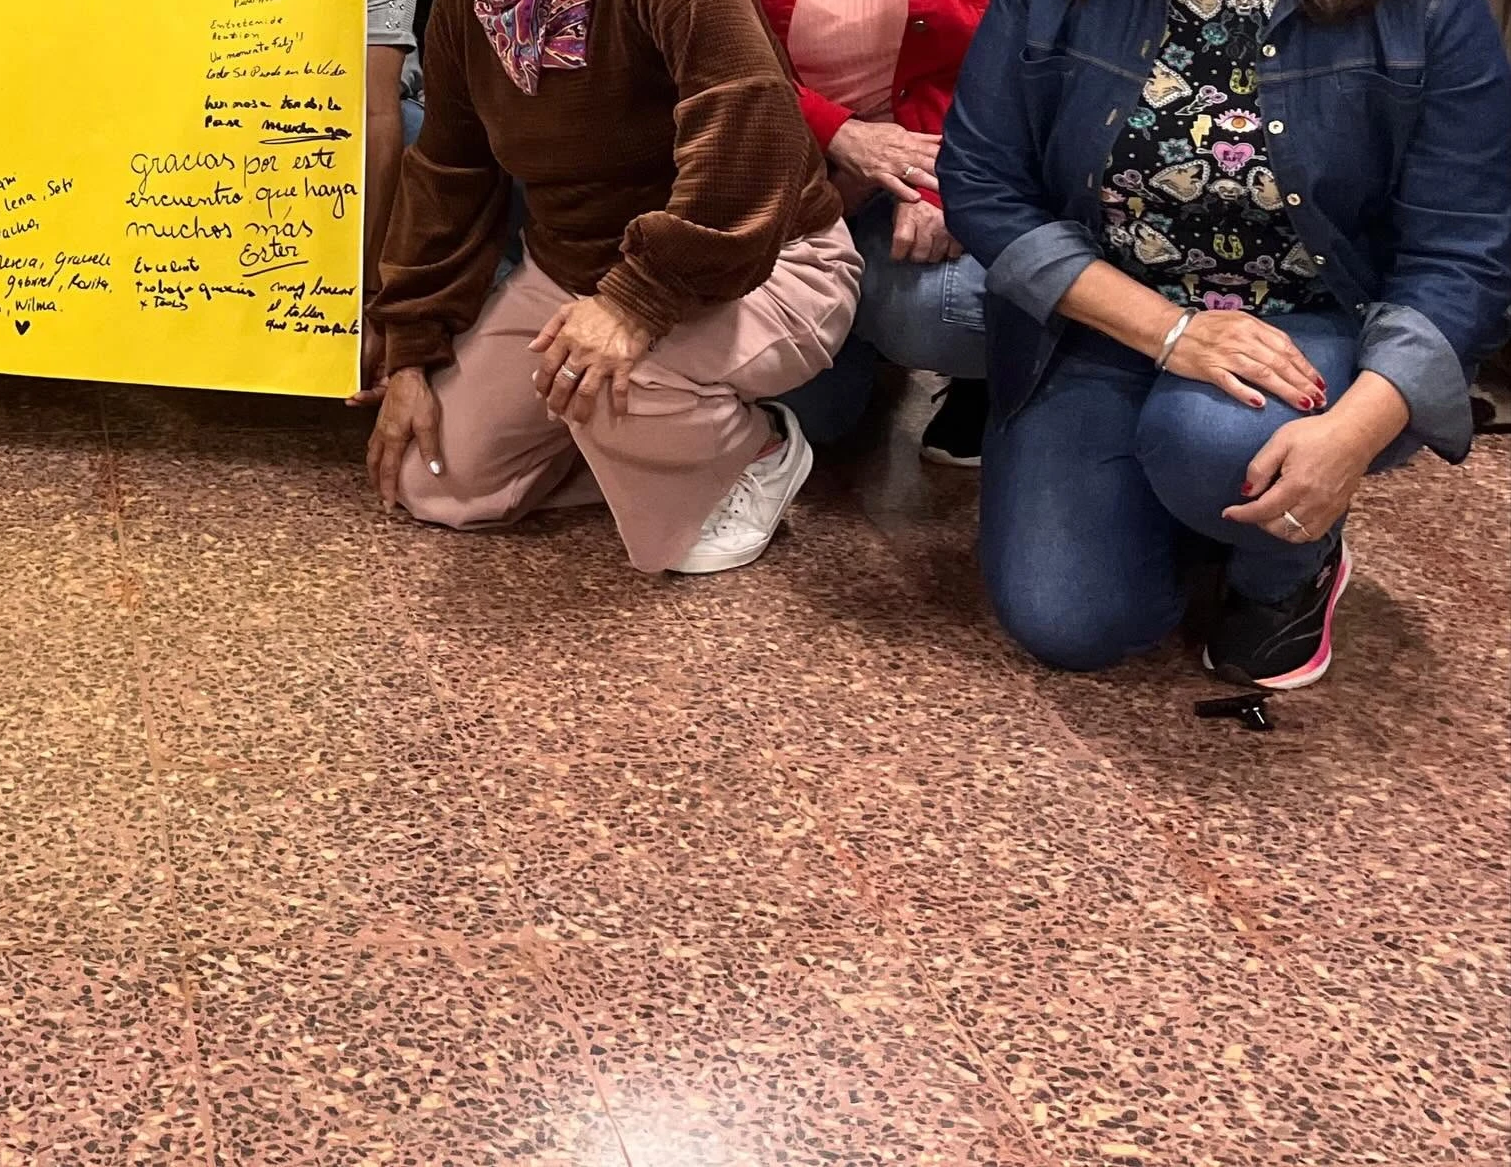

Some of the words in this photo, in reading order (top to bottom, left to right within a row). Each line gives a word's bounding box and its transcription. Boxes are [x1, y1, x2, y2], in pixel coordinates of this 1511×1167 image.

[243, 154, 280, 189] por
[291, 146, 337, 170] este
[255, 188, 299, 219] que
[304, 176, 359, 219] haya
[125, 215, 233, 239] muchos
[238, 236, 299, 267] Ester
